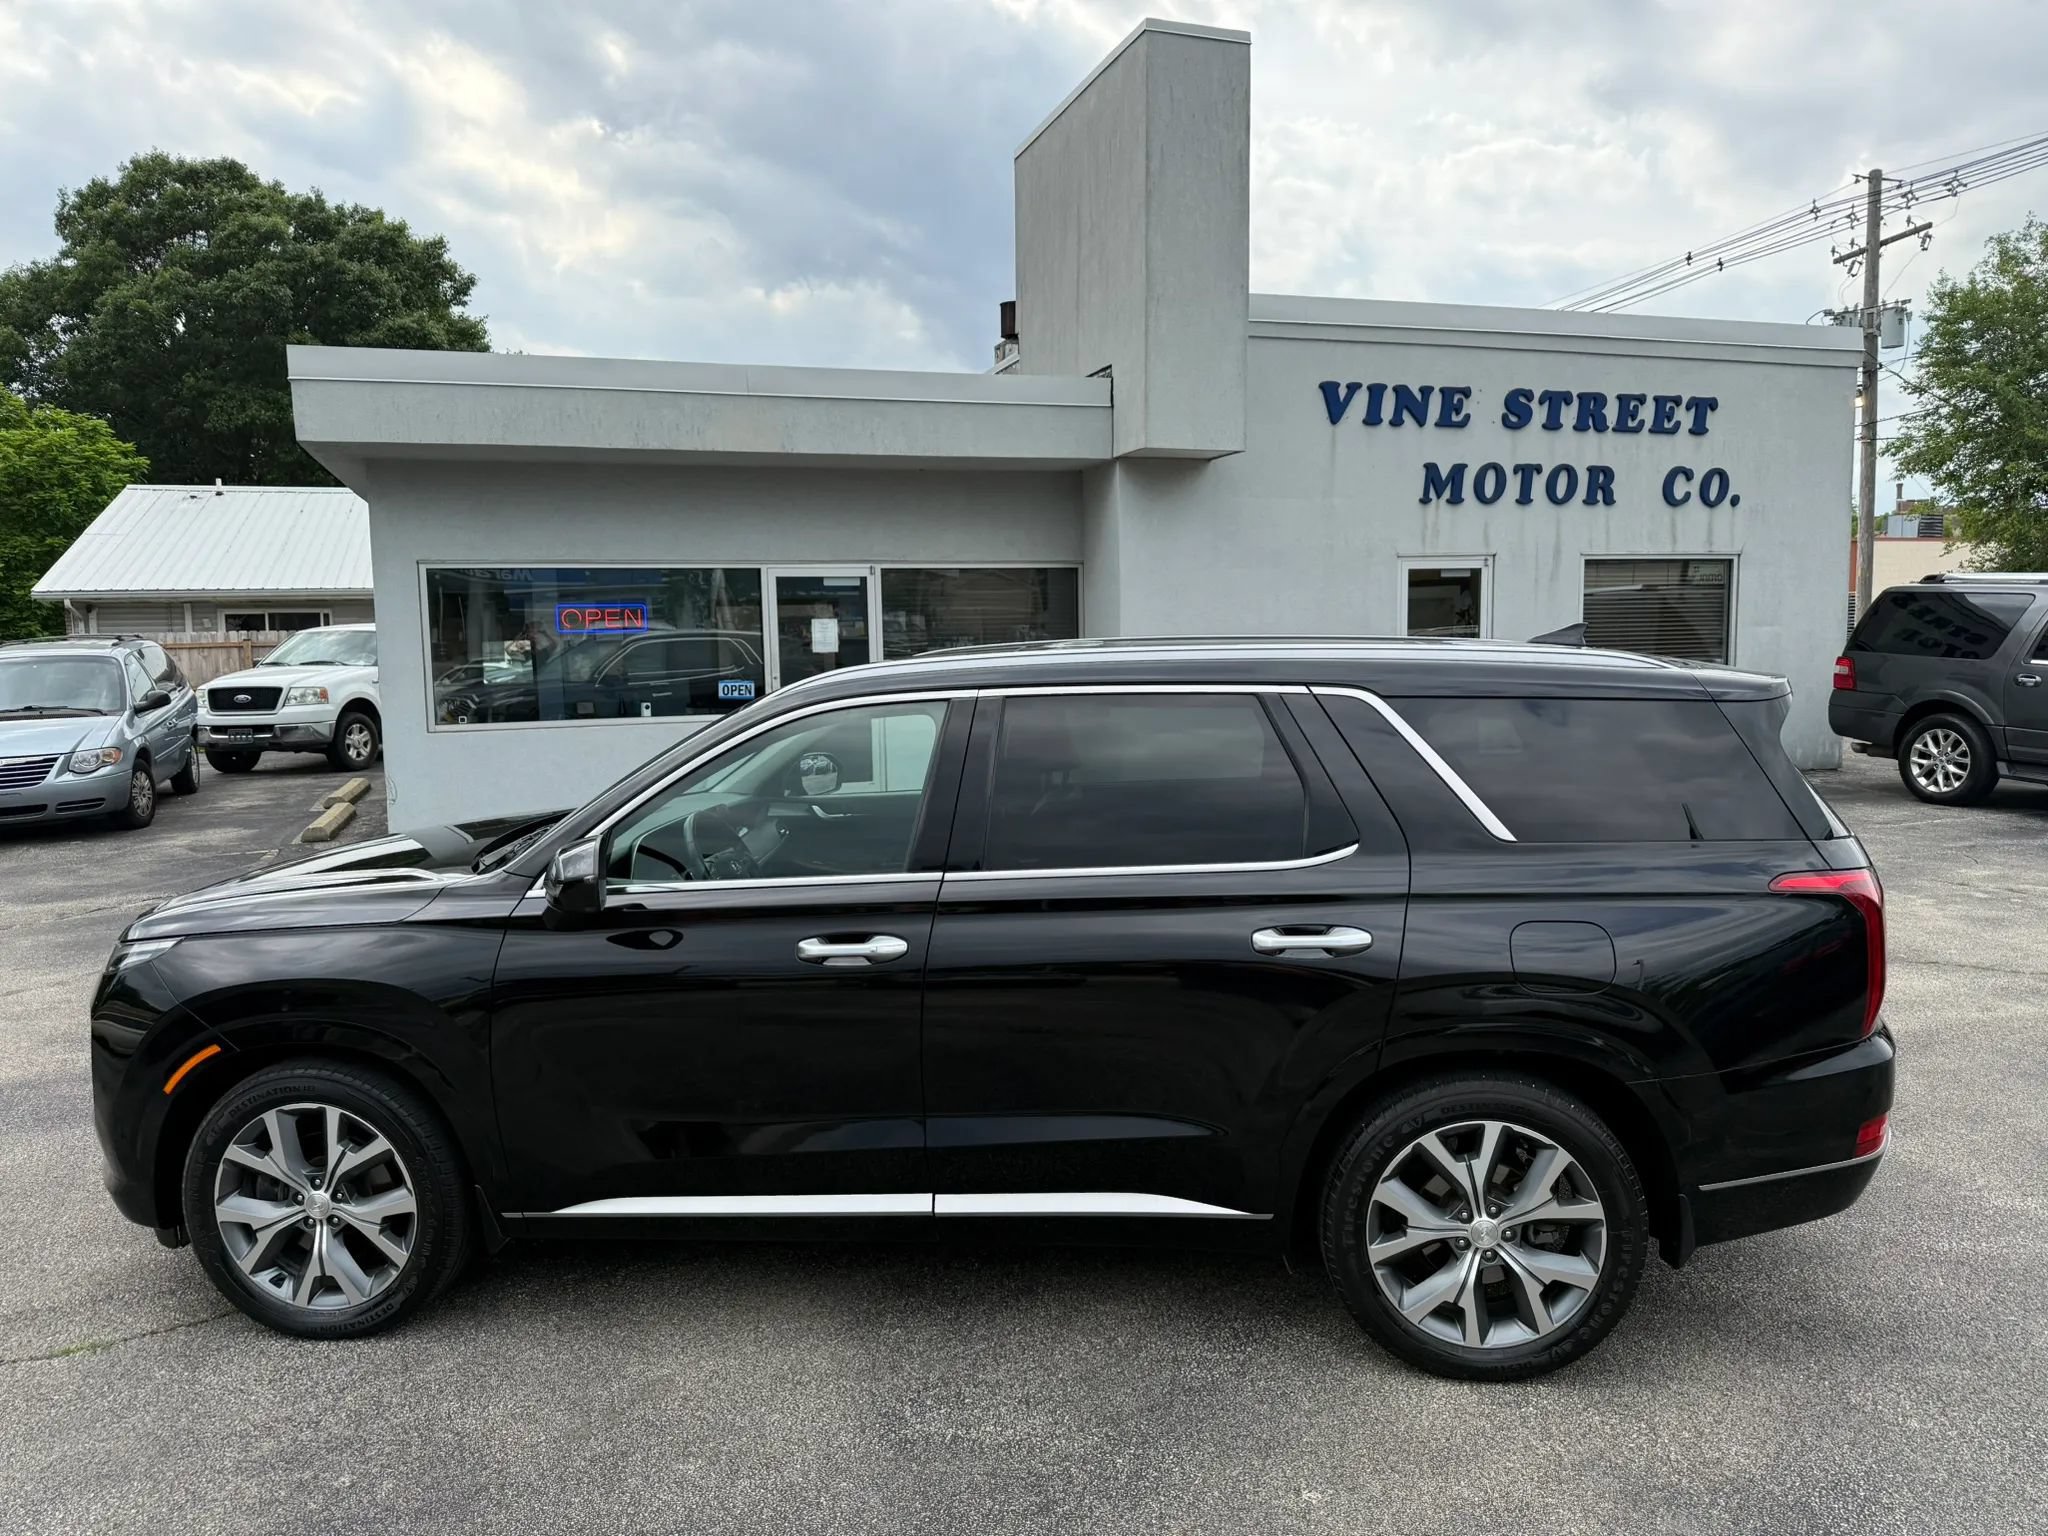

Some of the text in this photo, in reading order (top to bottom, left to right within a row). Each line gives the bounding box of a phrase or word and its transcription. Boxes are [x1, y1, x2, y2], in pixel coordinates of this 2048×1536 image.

[1318, 380, 1718, 435] VINE STREET
[1419, 462, 1740, 507] MOTOR CO.
[561, 608, 643, 628] OPEN
[721, 683, 752, 696] OPEN
